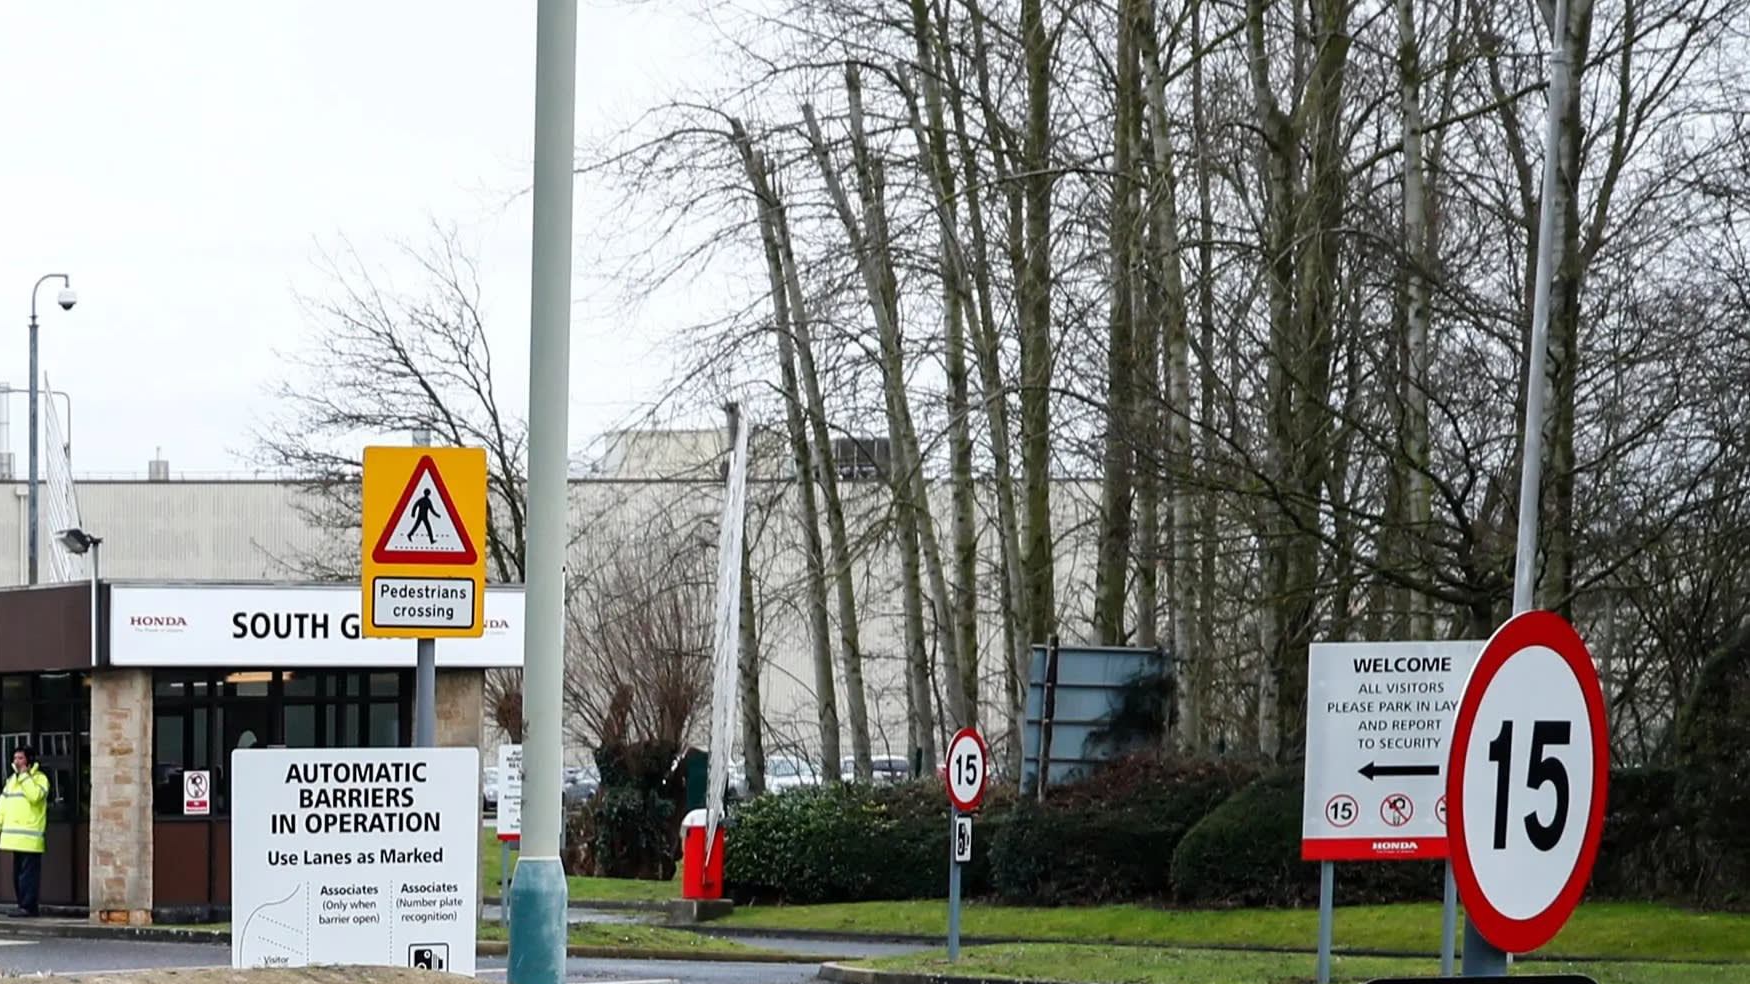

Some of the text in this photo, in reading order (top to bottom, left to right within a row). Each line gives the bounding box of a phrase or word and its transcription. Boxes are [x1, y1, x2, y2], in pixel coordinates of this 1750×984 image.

[380, 584, 467, 600] Pedestrians
[393, 604, 454, 620] crossing
[130, 616, 188, 626] HONDA
[232, 612, 329, 639] SOUTH
[1353, 657, 1452, 673] WELCOME
[1358, 682, 1445, 694] ALL VISITORS
[1327, 700, 1458, 713] PLEASE PARK IN LAY
[1358, 719, 1442, 731] AND REPORT
[1358, 737, 1441, 749] TO SECURITY
[285, 763, 427, 783] AUTOMATIC
[956, 754, 977, 786] 15
[1489, 720, 1571, 852] 15
[299, 788, 414, 808] BARRIERS
[1330, 802, 1352, 820] 15
[272, 812, 440, 834] IN OPERATION
[1372, 841, 1418, 850] HONDA
[268, 848, 443, 866] Use Lanes as Marked
[320, 884, 379, 895] Associates
[401, 882, 458, 893] Associates
[322, 900, 376, 911] (Only when
[396, 898, 463, 908] (Number plate
[319, 914, 379, 925] barrier open)
[401, 912, 457, 923] recognition)
[264, 956, 289, 964] Visitor
